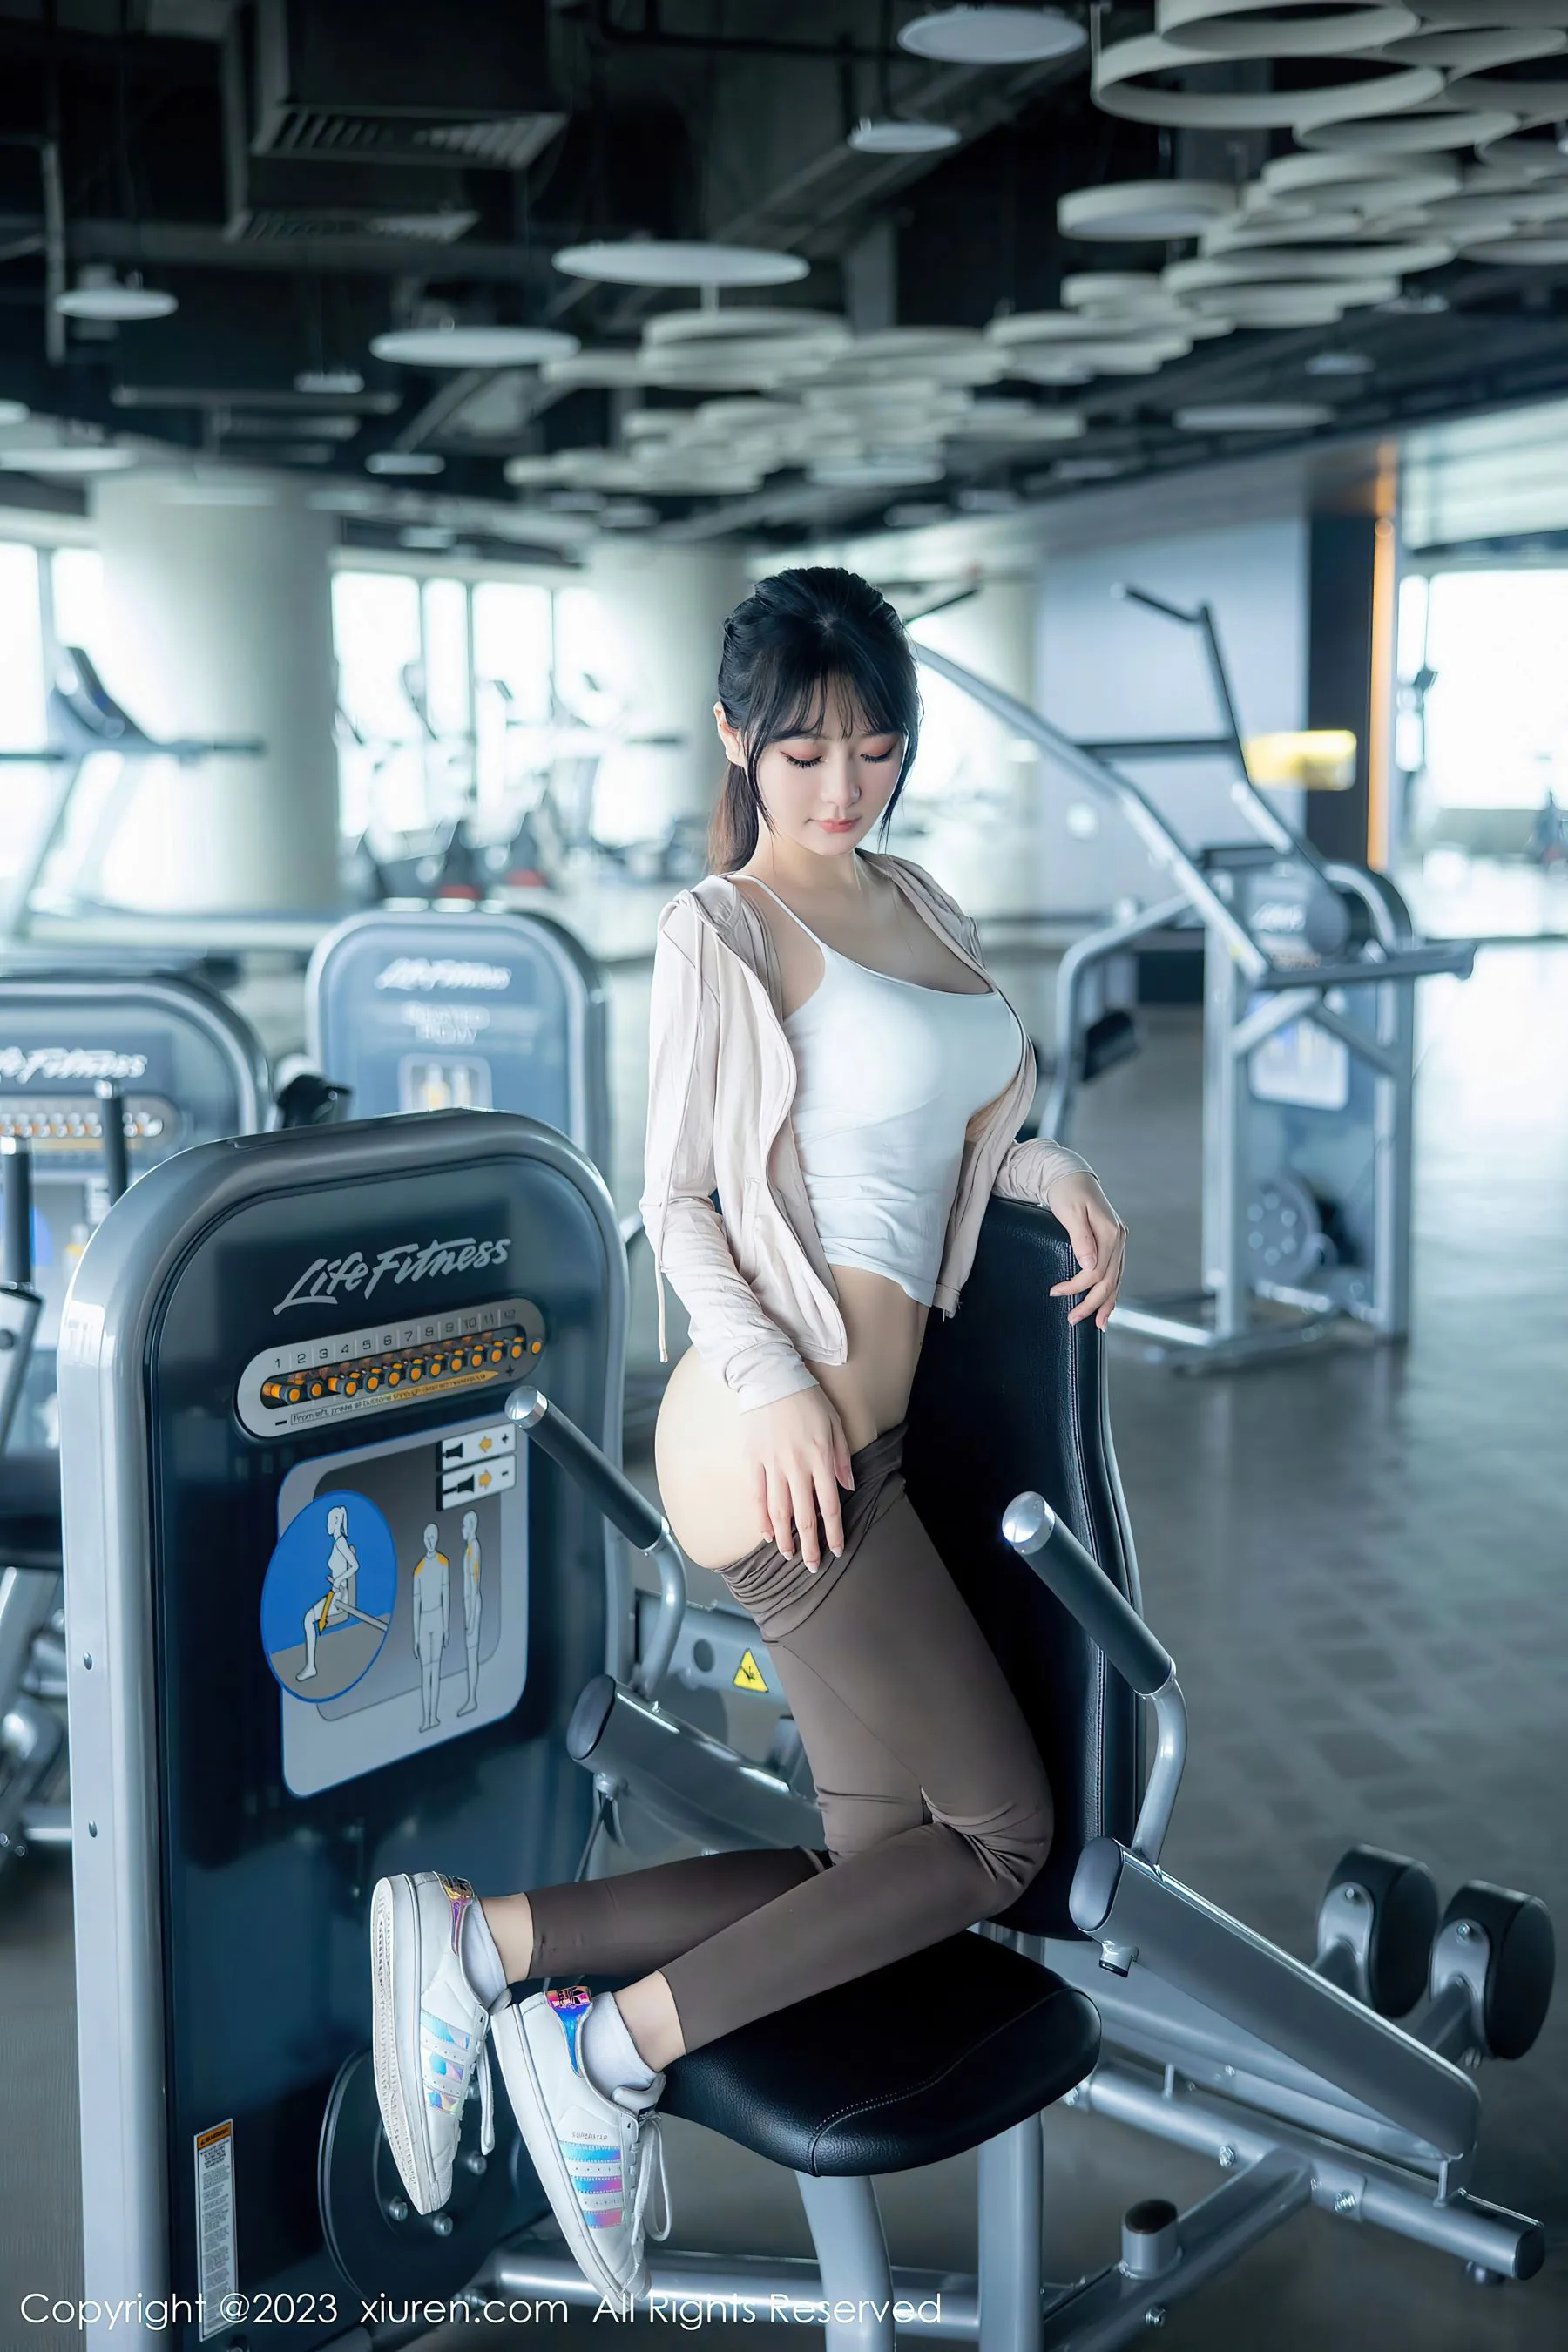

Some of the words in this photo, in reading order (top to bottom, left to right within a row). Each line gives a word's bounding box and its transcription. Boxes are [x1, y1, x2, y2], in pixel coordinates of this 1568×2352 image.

[273, 1252, 368, 1315] Life
[364, 1238, 512, 1300] Fitness
[274, 1358, 280, 1368] 1
[297, 1353, 307, 1364] 2
[319, 1348, 328, 1360] 3
[341, 1344, 349, 1355] 4
[362, 1340, 372, 1350] 5
[383, 1335, 393, 1346] 6
[404, 1330, 413, 1342] 7
[424, 1326, 434, 1337] 8
[445, 1321, 455, 1333] 9
[463, 1316, 477, 1329] 10
[483, 1313, 495, 1325] 11
